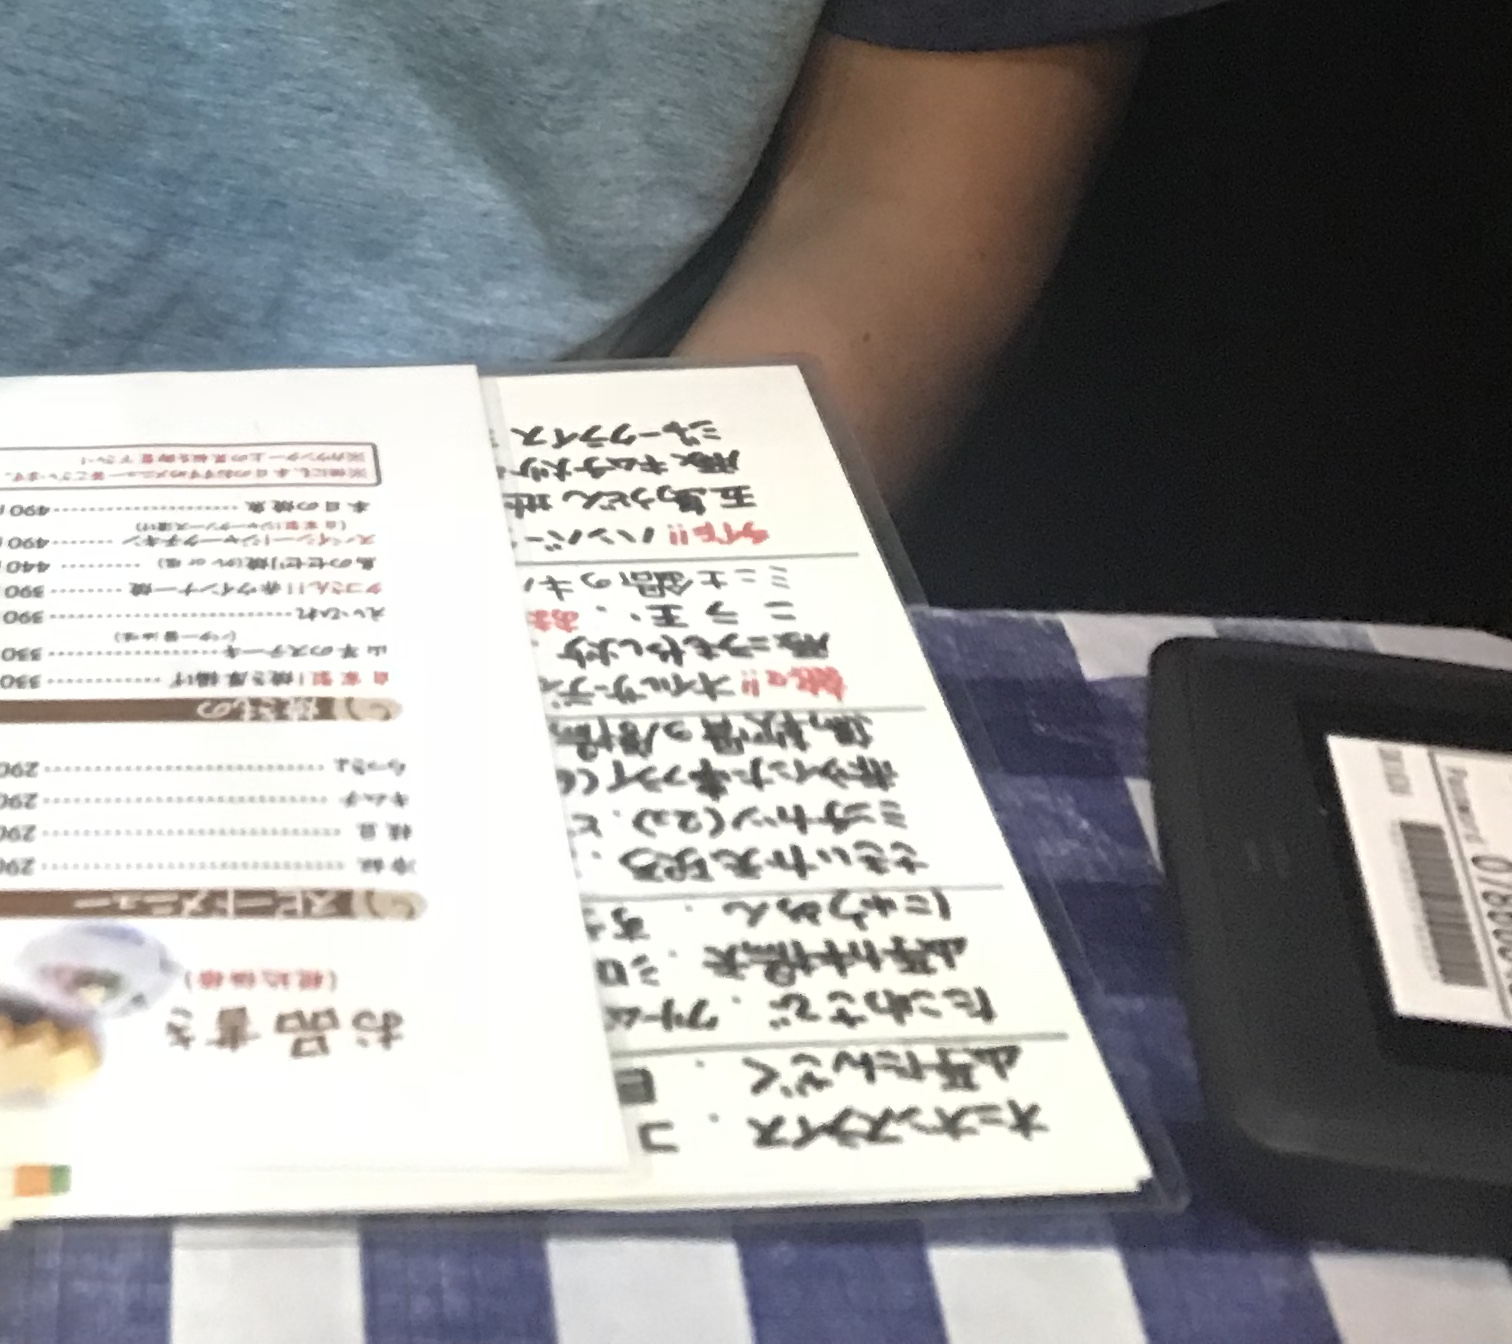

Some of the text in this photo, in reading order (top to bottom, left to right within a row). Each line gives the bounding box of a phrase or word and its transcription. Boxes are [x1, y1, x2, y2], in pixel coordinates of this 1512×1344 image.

[509, 526, 655, 552] ハンバー
[164, 1006, 404, 1059] お品書き
